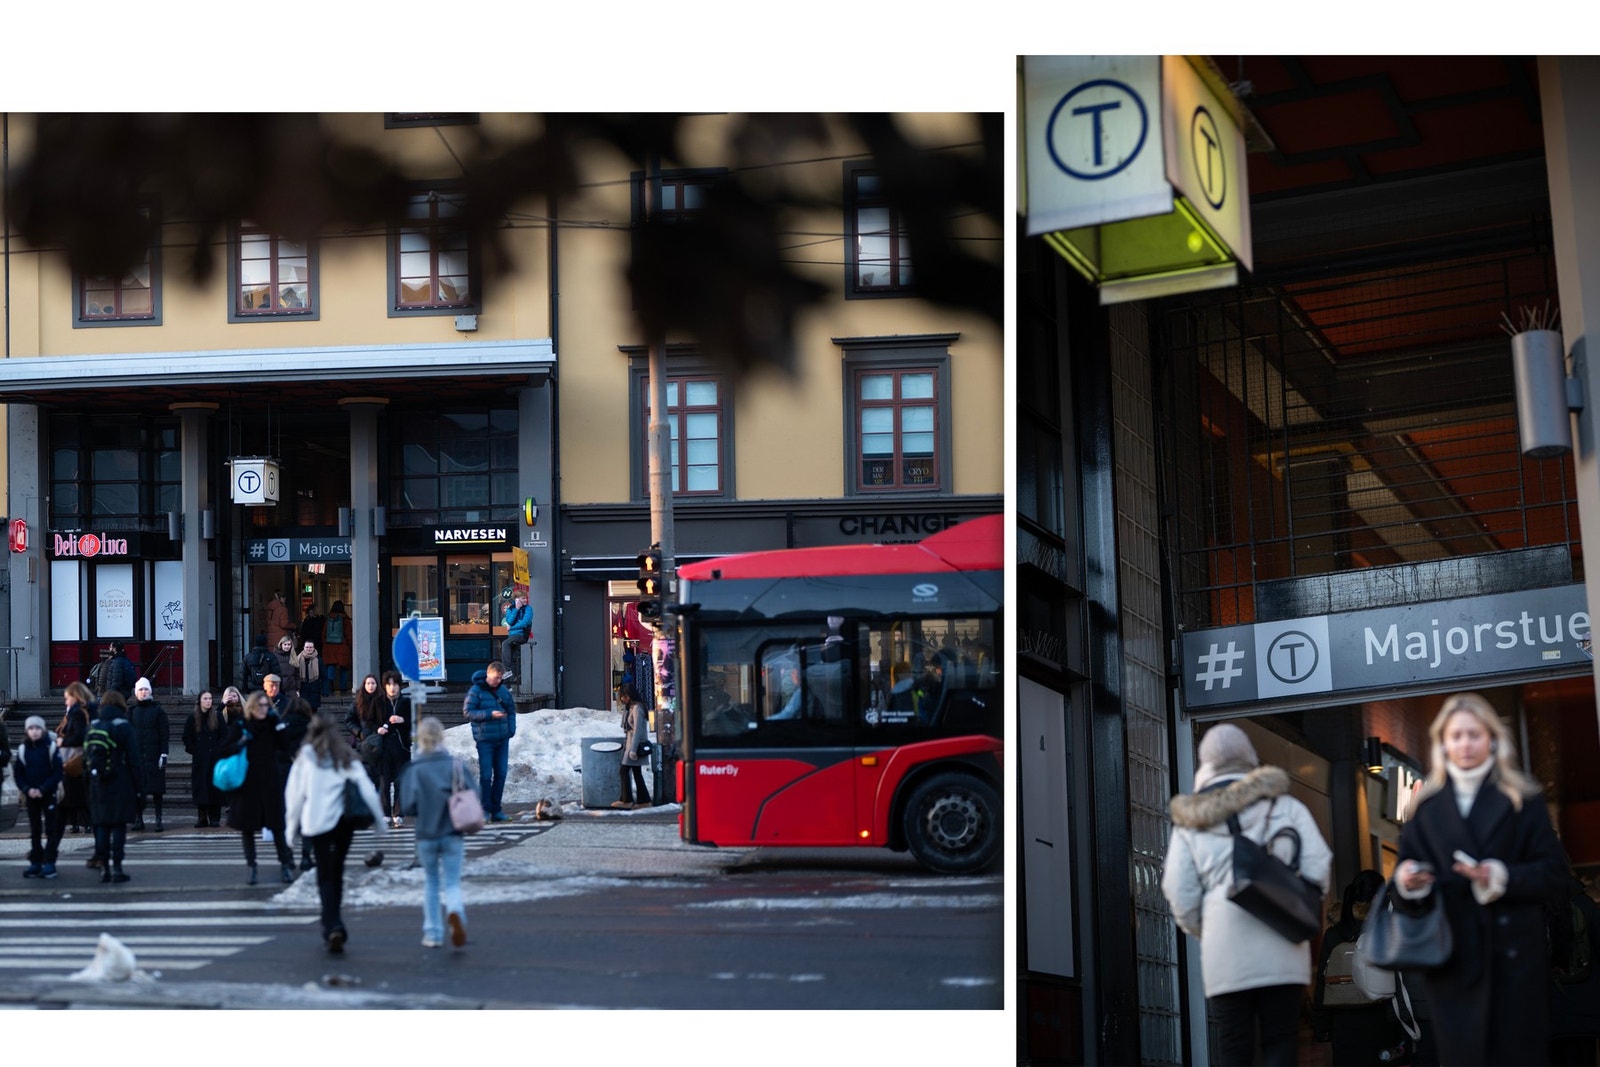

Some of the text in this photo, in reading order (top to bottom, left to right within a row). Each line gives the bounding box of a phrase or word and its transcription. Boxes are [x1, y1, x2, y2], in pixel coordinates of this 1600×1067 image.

[1072, 101, 1121, 167] T
[435, 528, 506, 541] NARVESEN
[54, 532, 128, 557] Deli de Luca
[300, 543, 352, 558] Majorst
[99, 599, 131, 608] CLASSIC
[1364, 611, 1590, 669] Majorstue
[699, 764, 739, 777] RuterBy
